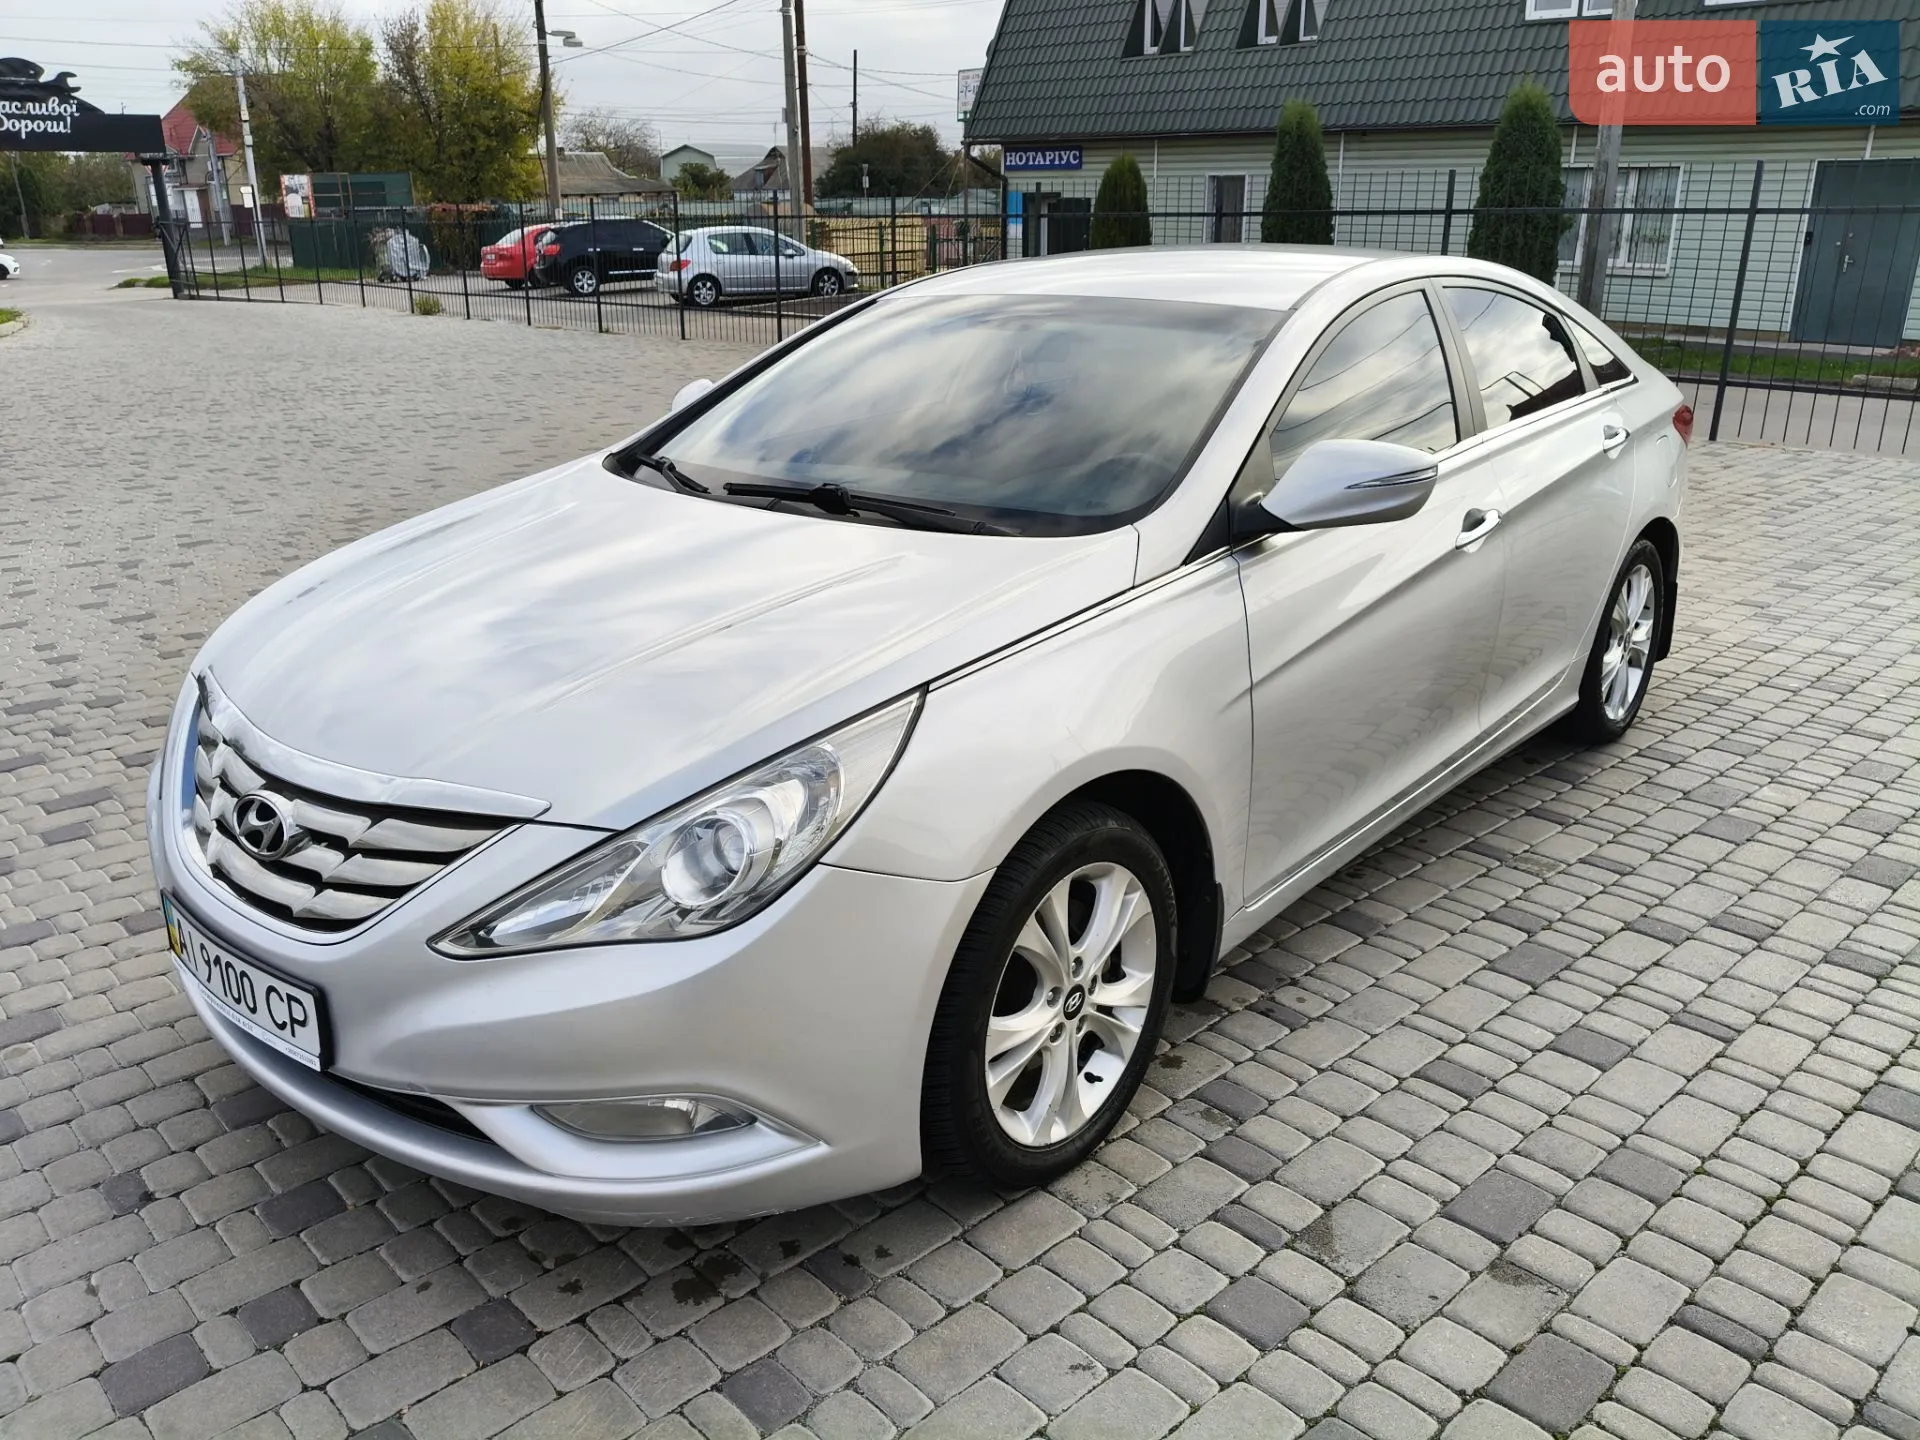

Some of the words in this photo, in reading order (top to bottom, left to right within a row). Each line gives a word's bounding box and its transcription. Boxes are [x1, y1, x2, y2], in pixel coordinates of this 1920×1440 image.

[1005, 150, 1080, 166] НОТАРІУС
[200, 942, 258, 1015] 9100
[265, 984, 308, 1038] CP
